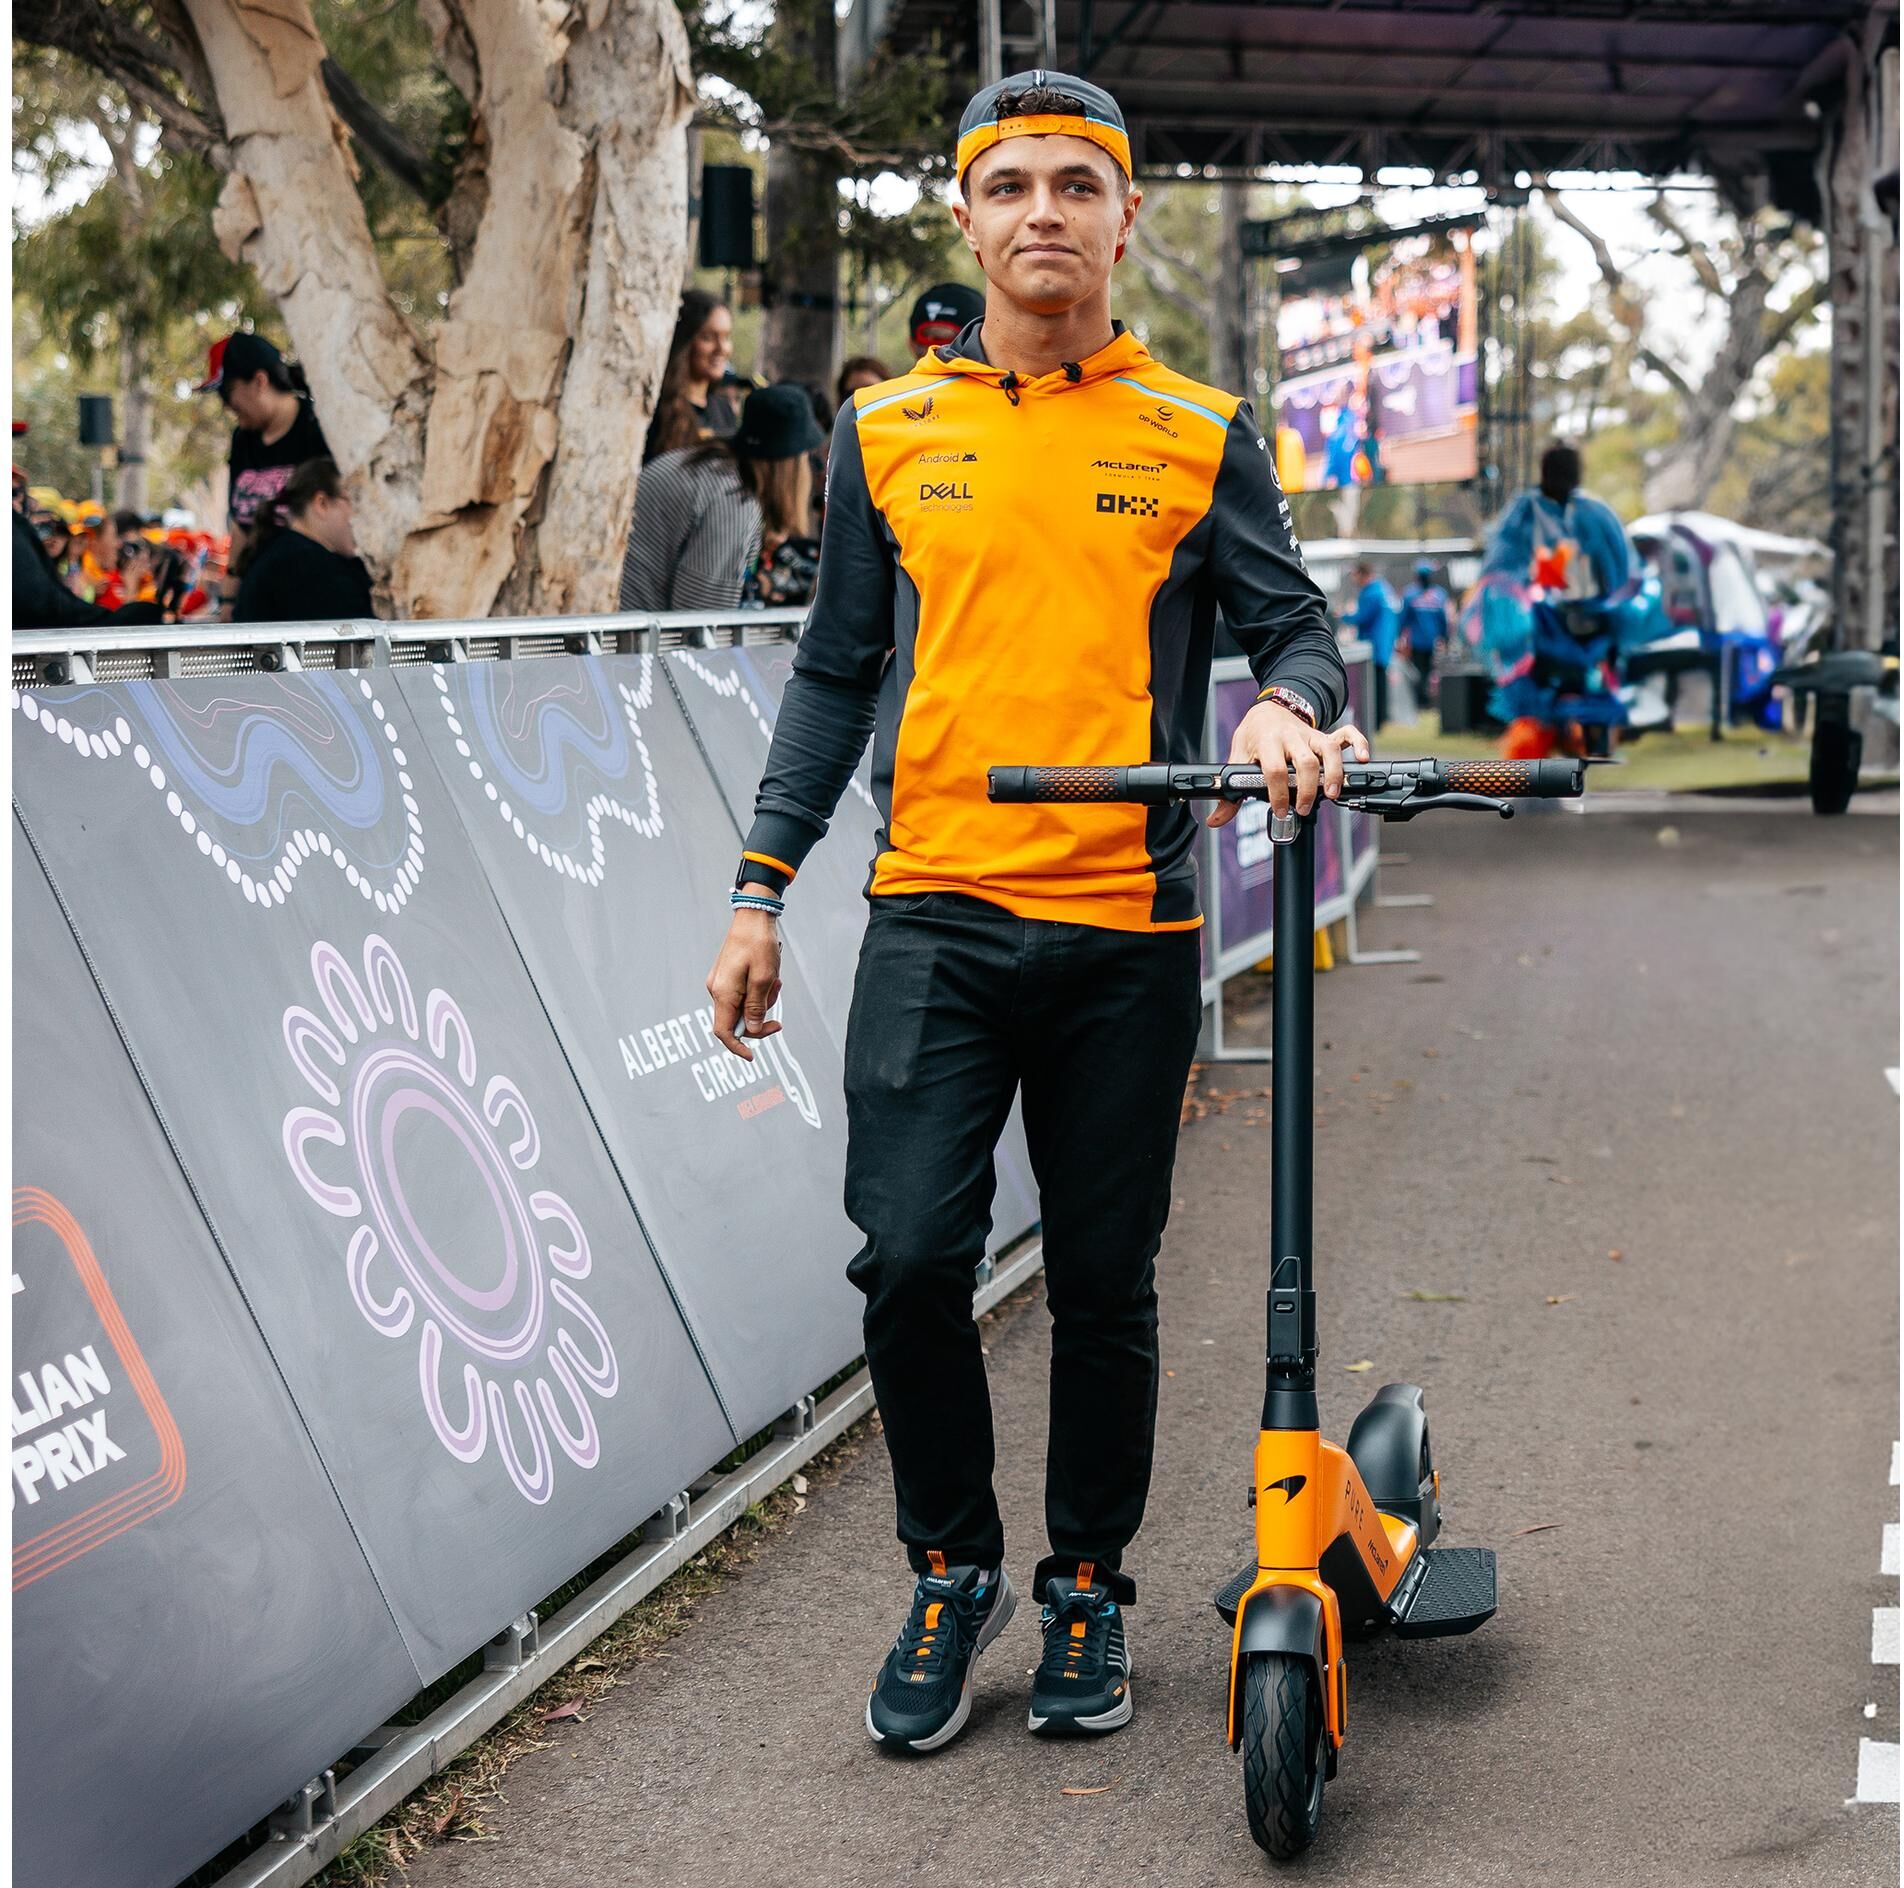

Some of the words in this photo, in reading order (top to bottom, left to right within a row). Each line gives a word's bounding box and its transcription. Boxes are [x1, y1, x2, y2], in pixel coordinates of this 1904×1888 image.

[1150, 419, 1178, 439] WORLD
[918, 452, 960, 464] Android
[1091, 460, 1164, 473] McLaren
[920, 482, 974, 501] DELL
[920, 502, 974, 514] Technologies
[1096, 493, 1159, 517] OKX
[617, 1014, 702, 1081] ALBERT
[690, 1040, 772, 1102] CIRCUIT
[12, 1345, 112, 1438] LIAN
[12, 1409, 128, 1504] PRIX
[1345, 1479, 1364, 1531] PURE
